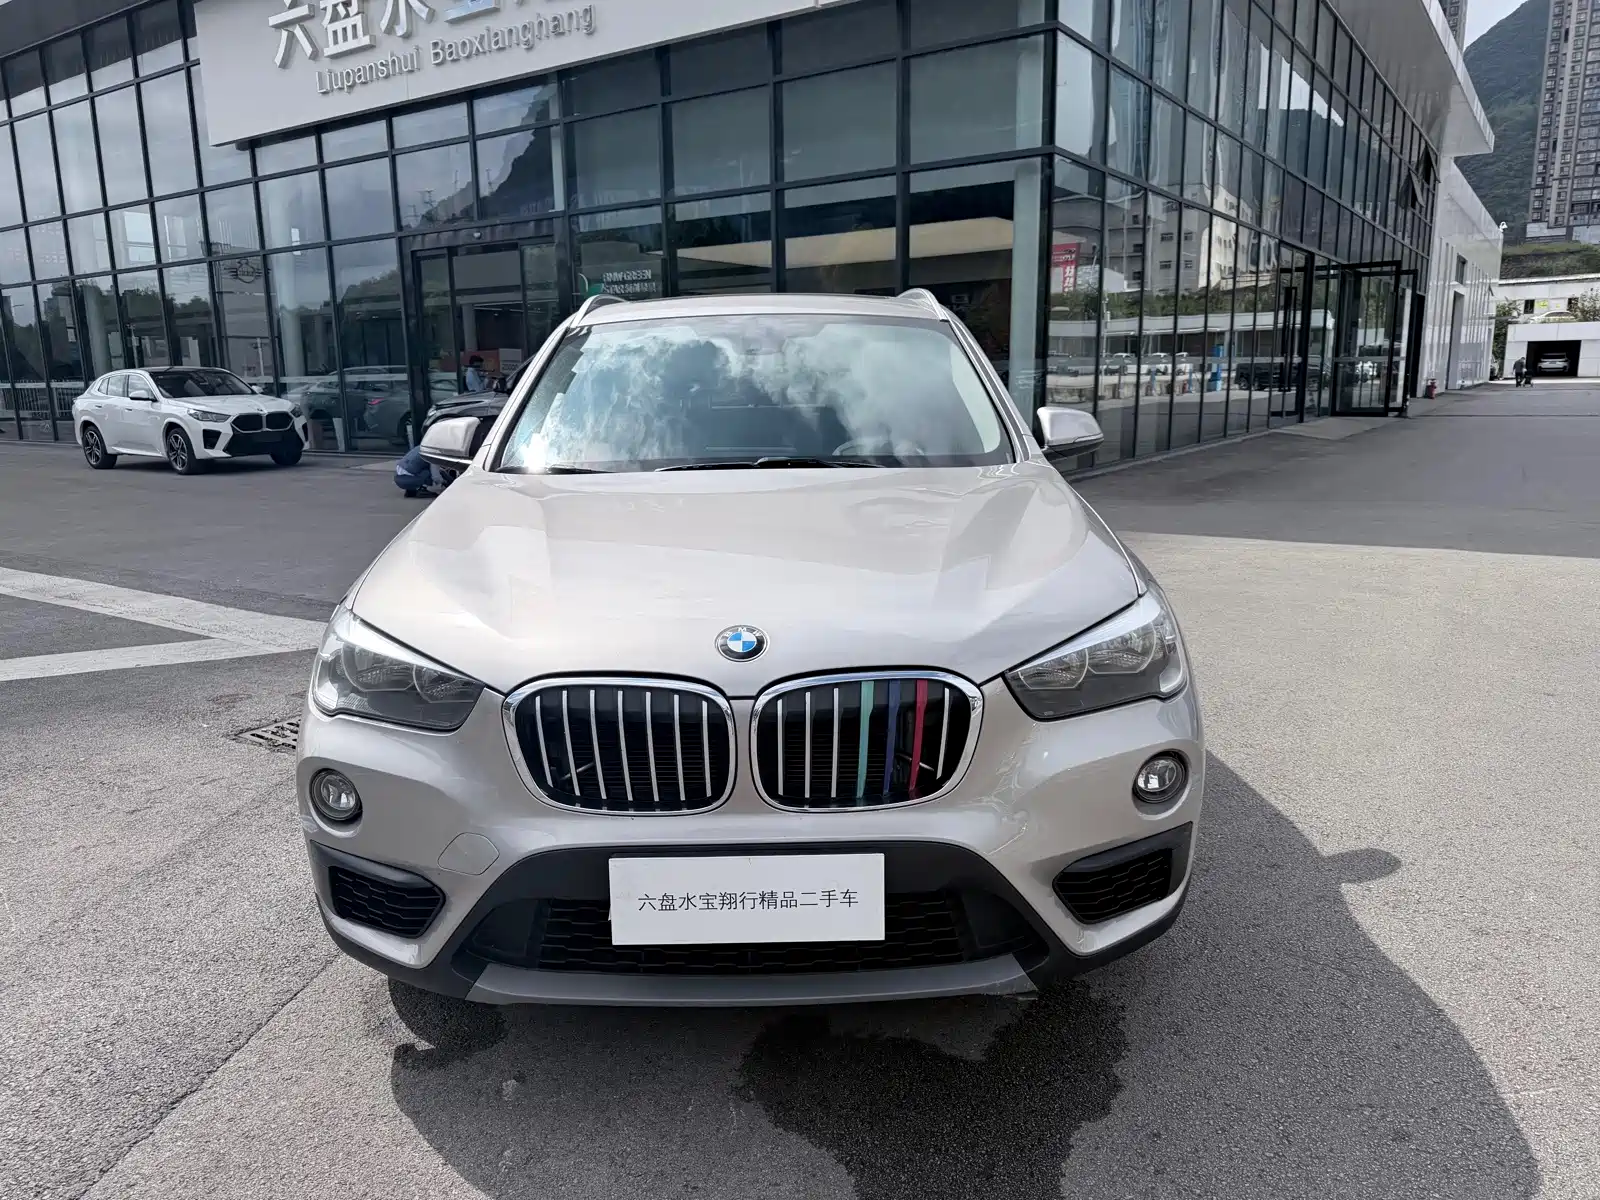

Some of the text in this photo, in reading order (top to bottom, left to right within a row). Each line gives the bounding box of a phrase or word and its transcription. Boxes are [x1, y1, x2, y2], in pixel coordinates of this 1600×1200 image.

[315, 4, 597, 94] Liupanshui Baoxianghang
[724, 626, 763, 637] BMW
[637, 888, 860, 912] 六盘水宝翔行精品二手车
